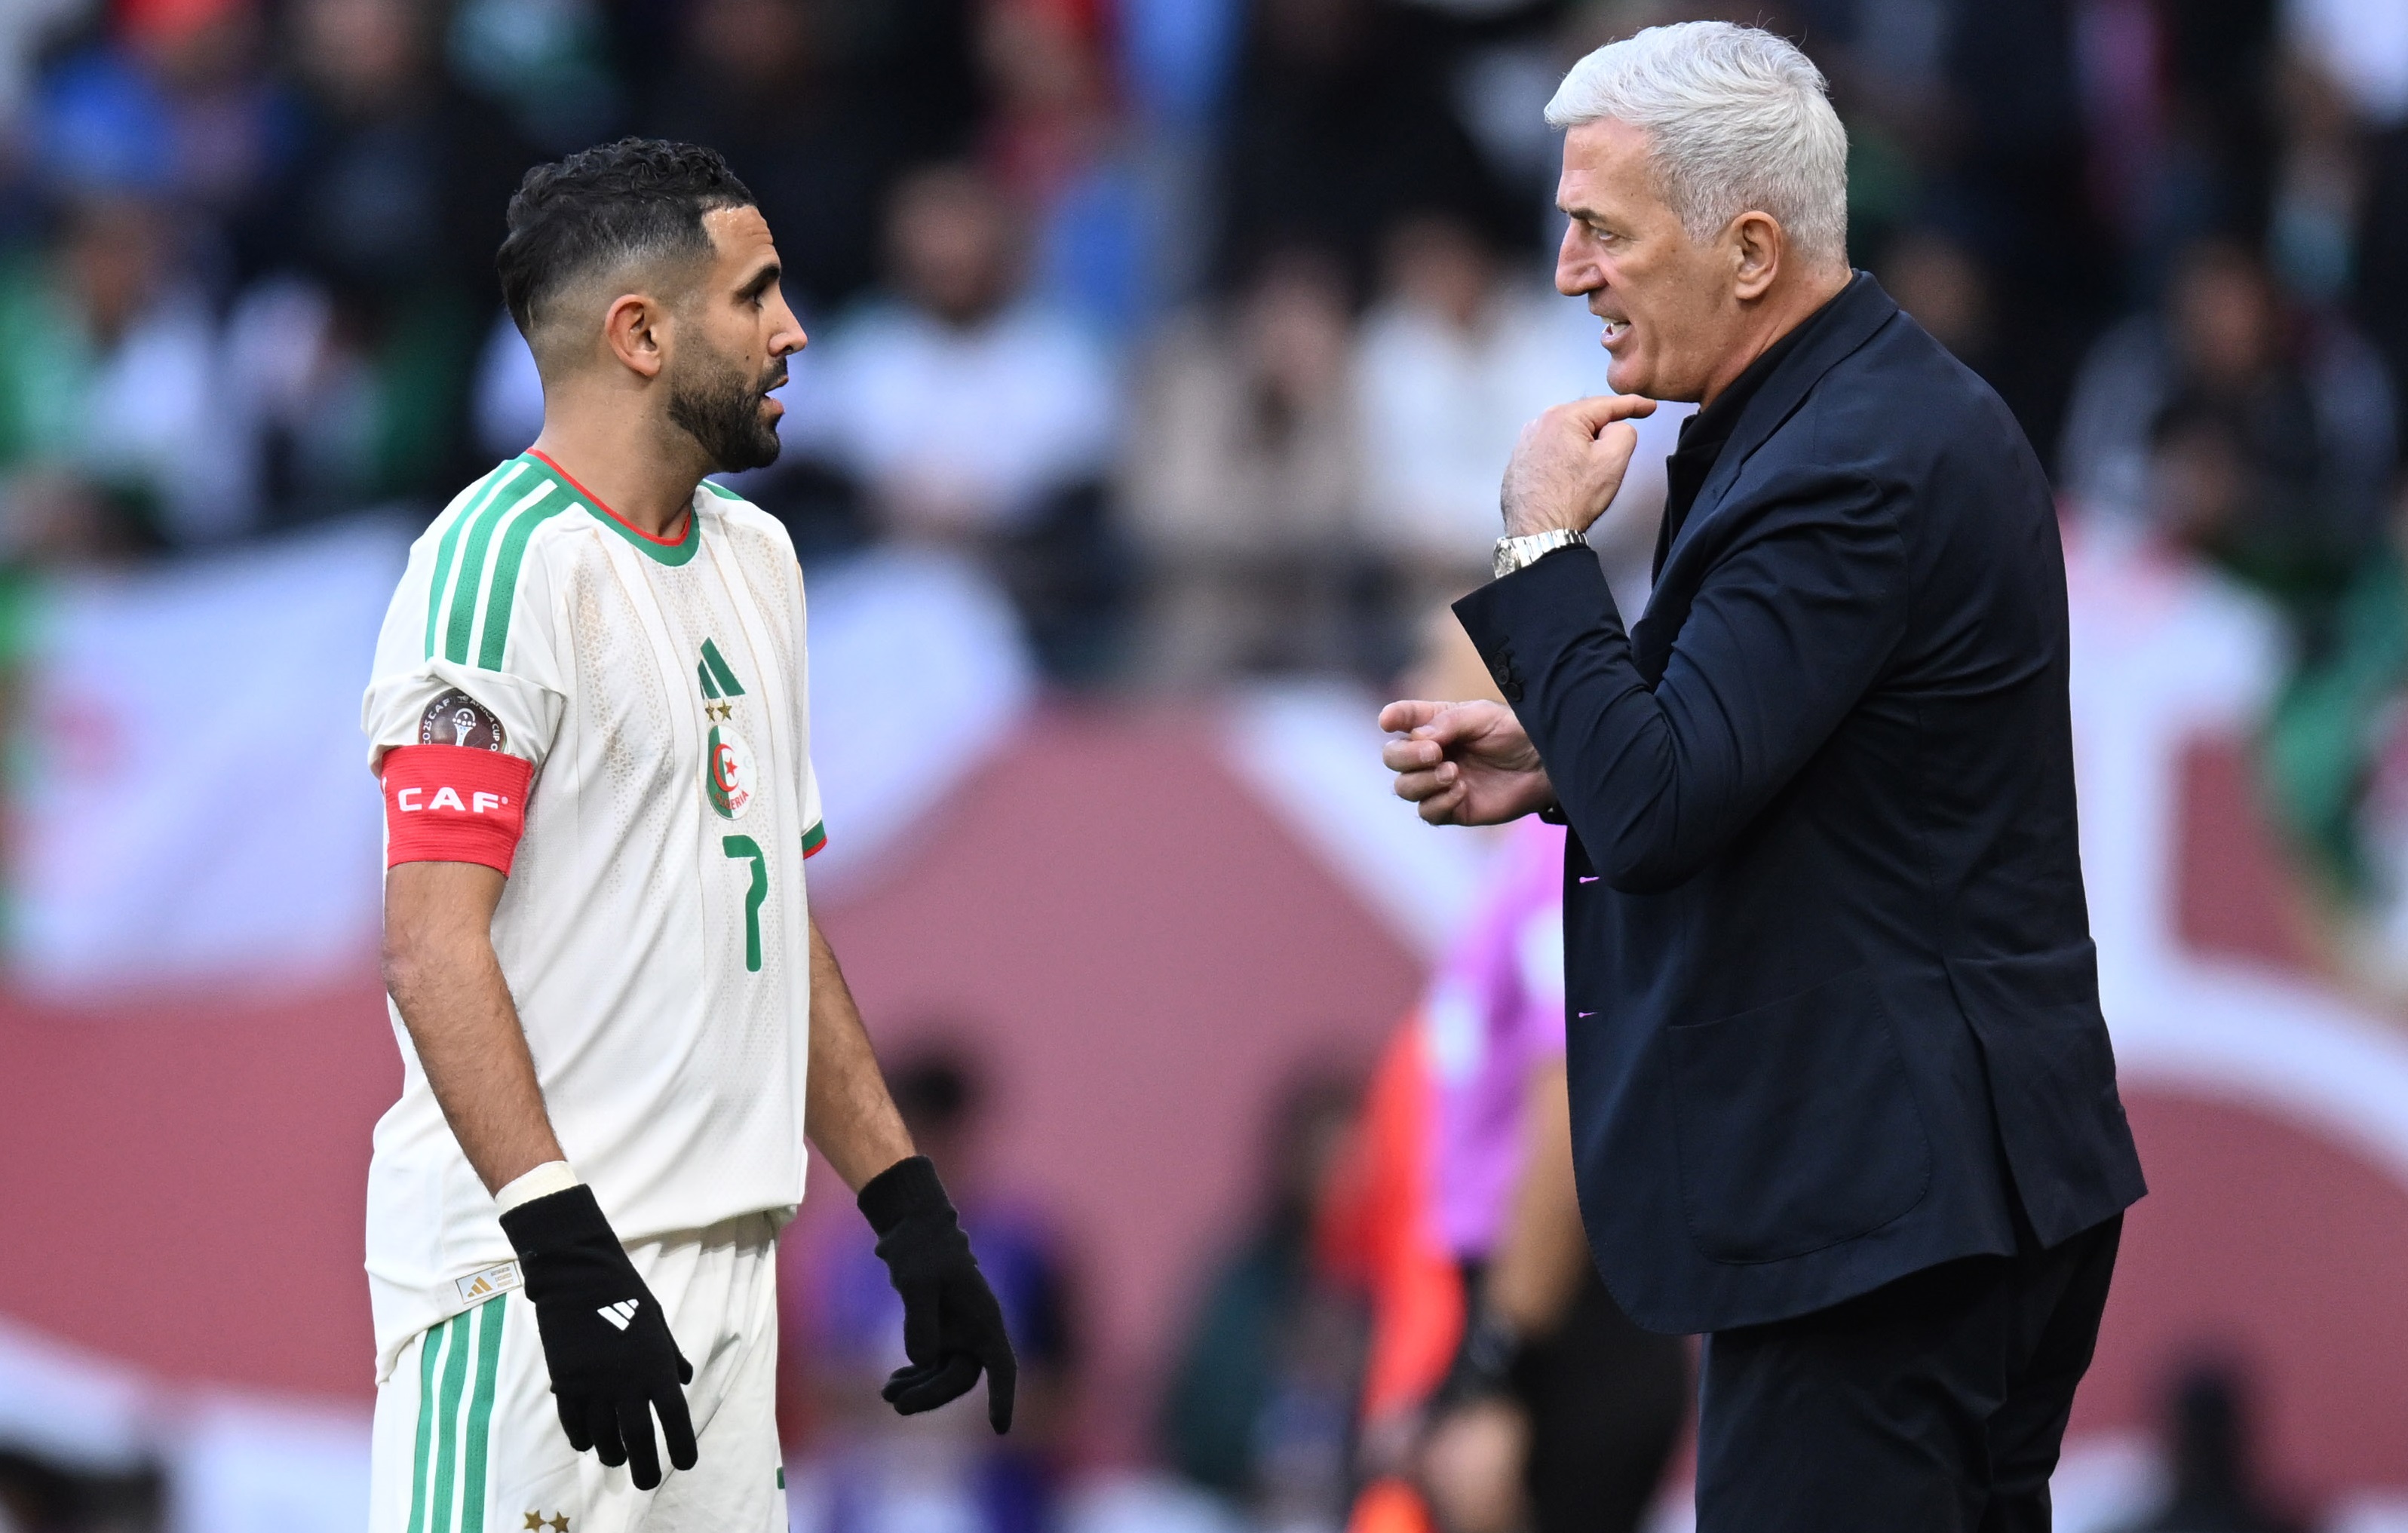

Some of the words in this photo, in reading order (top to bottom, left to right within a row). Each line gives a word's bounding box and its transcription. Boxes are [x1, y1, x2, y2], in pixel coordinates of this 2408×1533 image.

[428, 698, 450, 720] CAF
[492, 724, 501, 742] CUP
[490, 743, 498, 752] O
[397, 786, 499, 814] CAF
[714, 789, 749, 811] ALGERIA
[722, 834, 768, 973] 7
